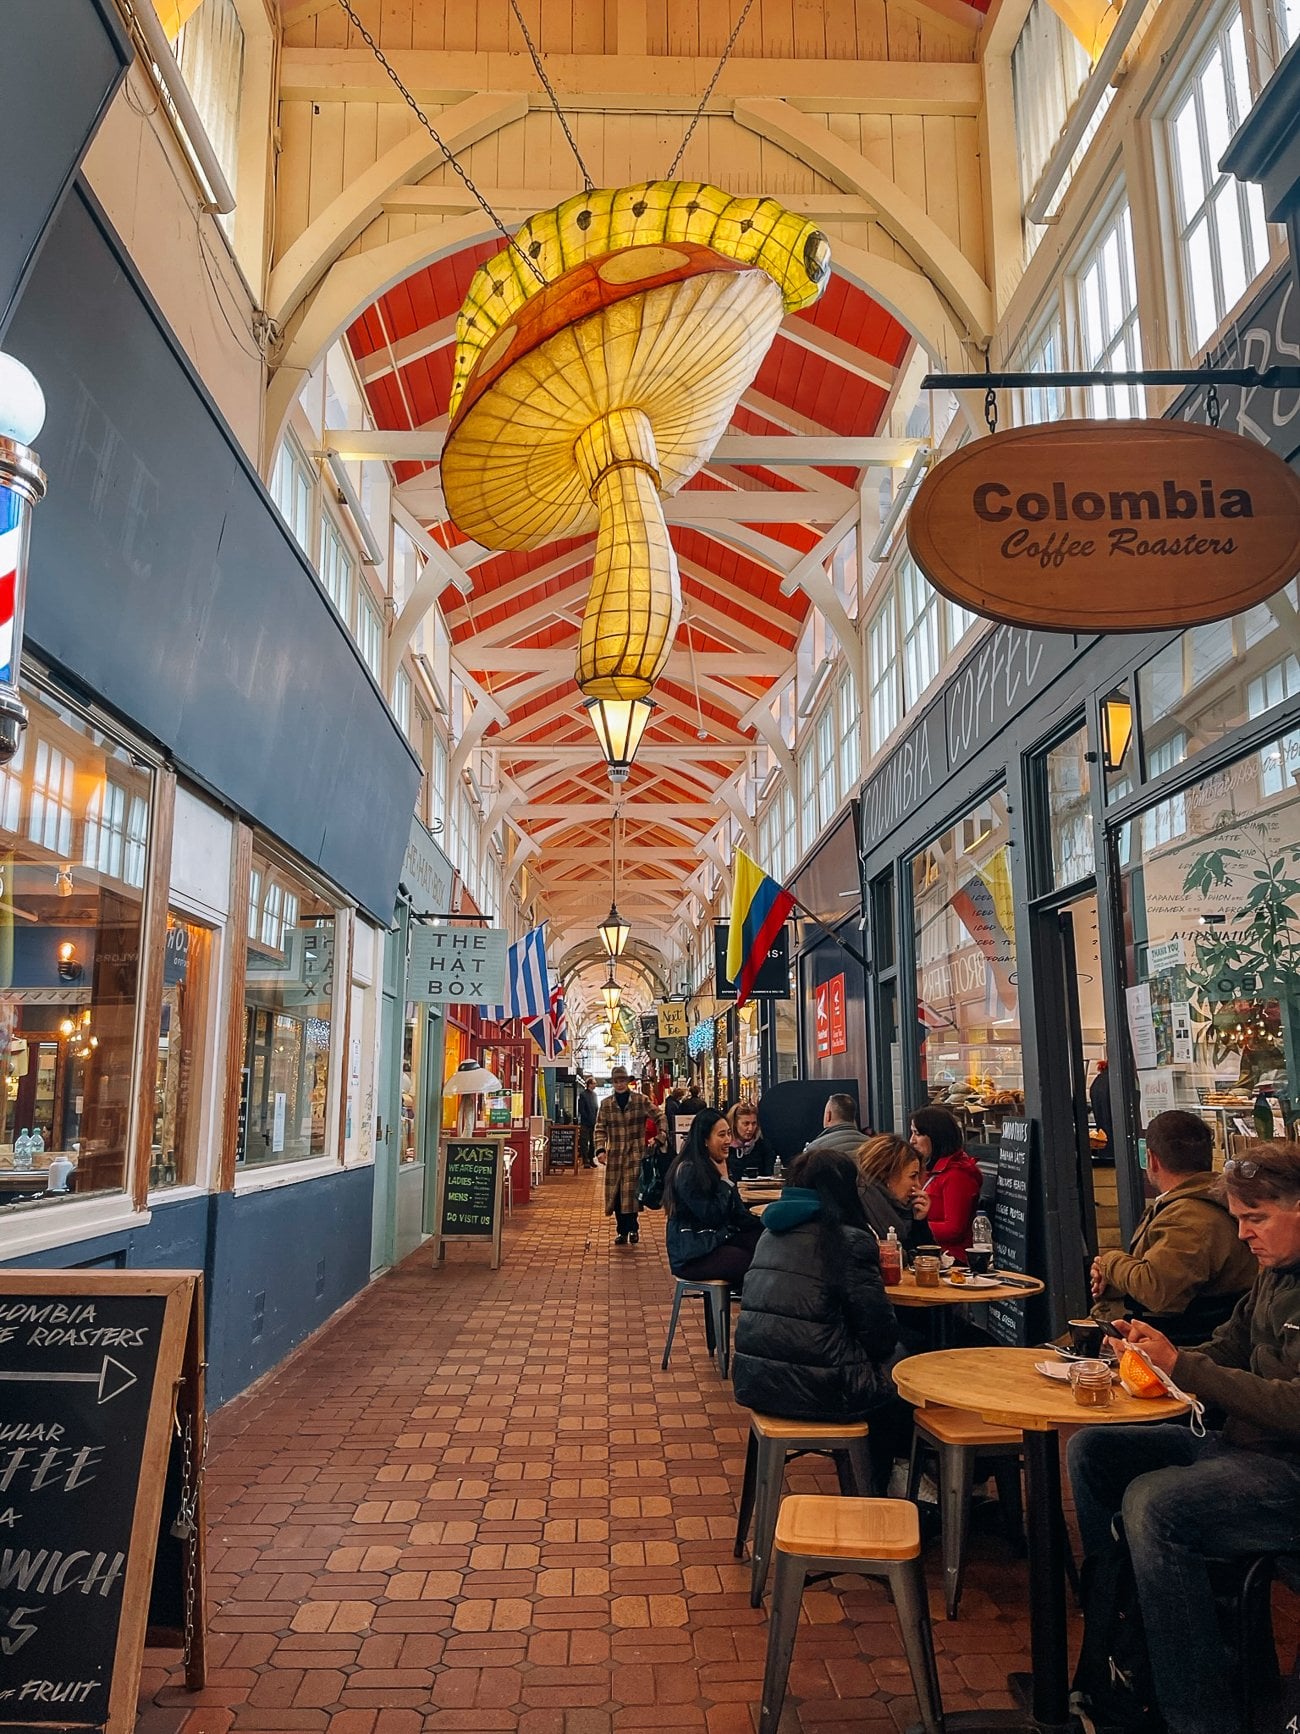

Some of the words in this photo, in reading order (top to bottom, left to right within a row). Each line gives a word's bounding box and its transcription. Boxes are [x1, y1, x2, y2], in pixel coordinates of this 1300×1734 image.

[972, 480, 1254, 522] Colombia
[1000, 527, 1096, 568] Coffee
[1108, 528, 1239, 557] Roasters
[863, 719, 933, 849] COLOMBIA
[433, 933, 487, 950] THE
[430, 957, 485, 973] HAT
[428, 980, 483, 997] BOX
[662, 1010, 683, 1023] Next
[664, 1024, 681, 1036] Too
[449, 1164, 459, 1172] WE
[459, 1164, 473, 1173] ARE
[474, 1165, 492, 1175] OPEN
[459, 1214, 478, 1224] VISIT
[481, 1216, 490, 1225] US
[27, 1326, 149, 1347] ROASTERS
[19, 1680, 101, 1704] FRUIT
